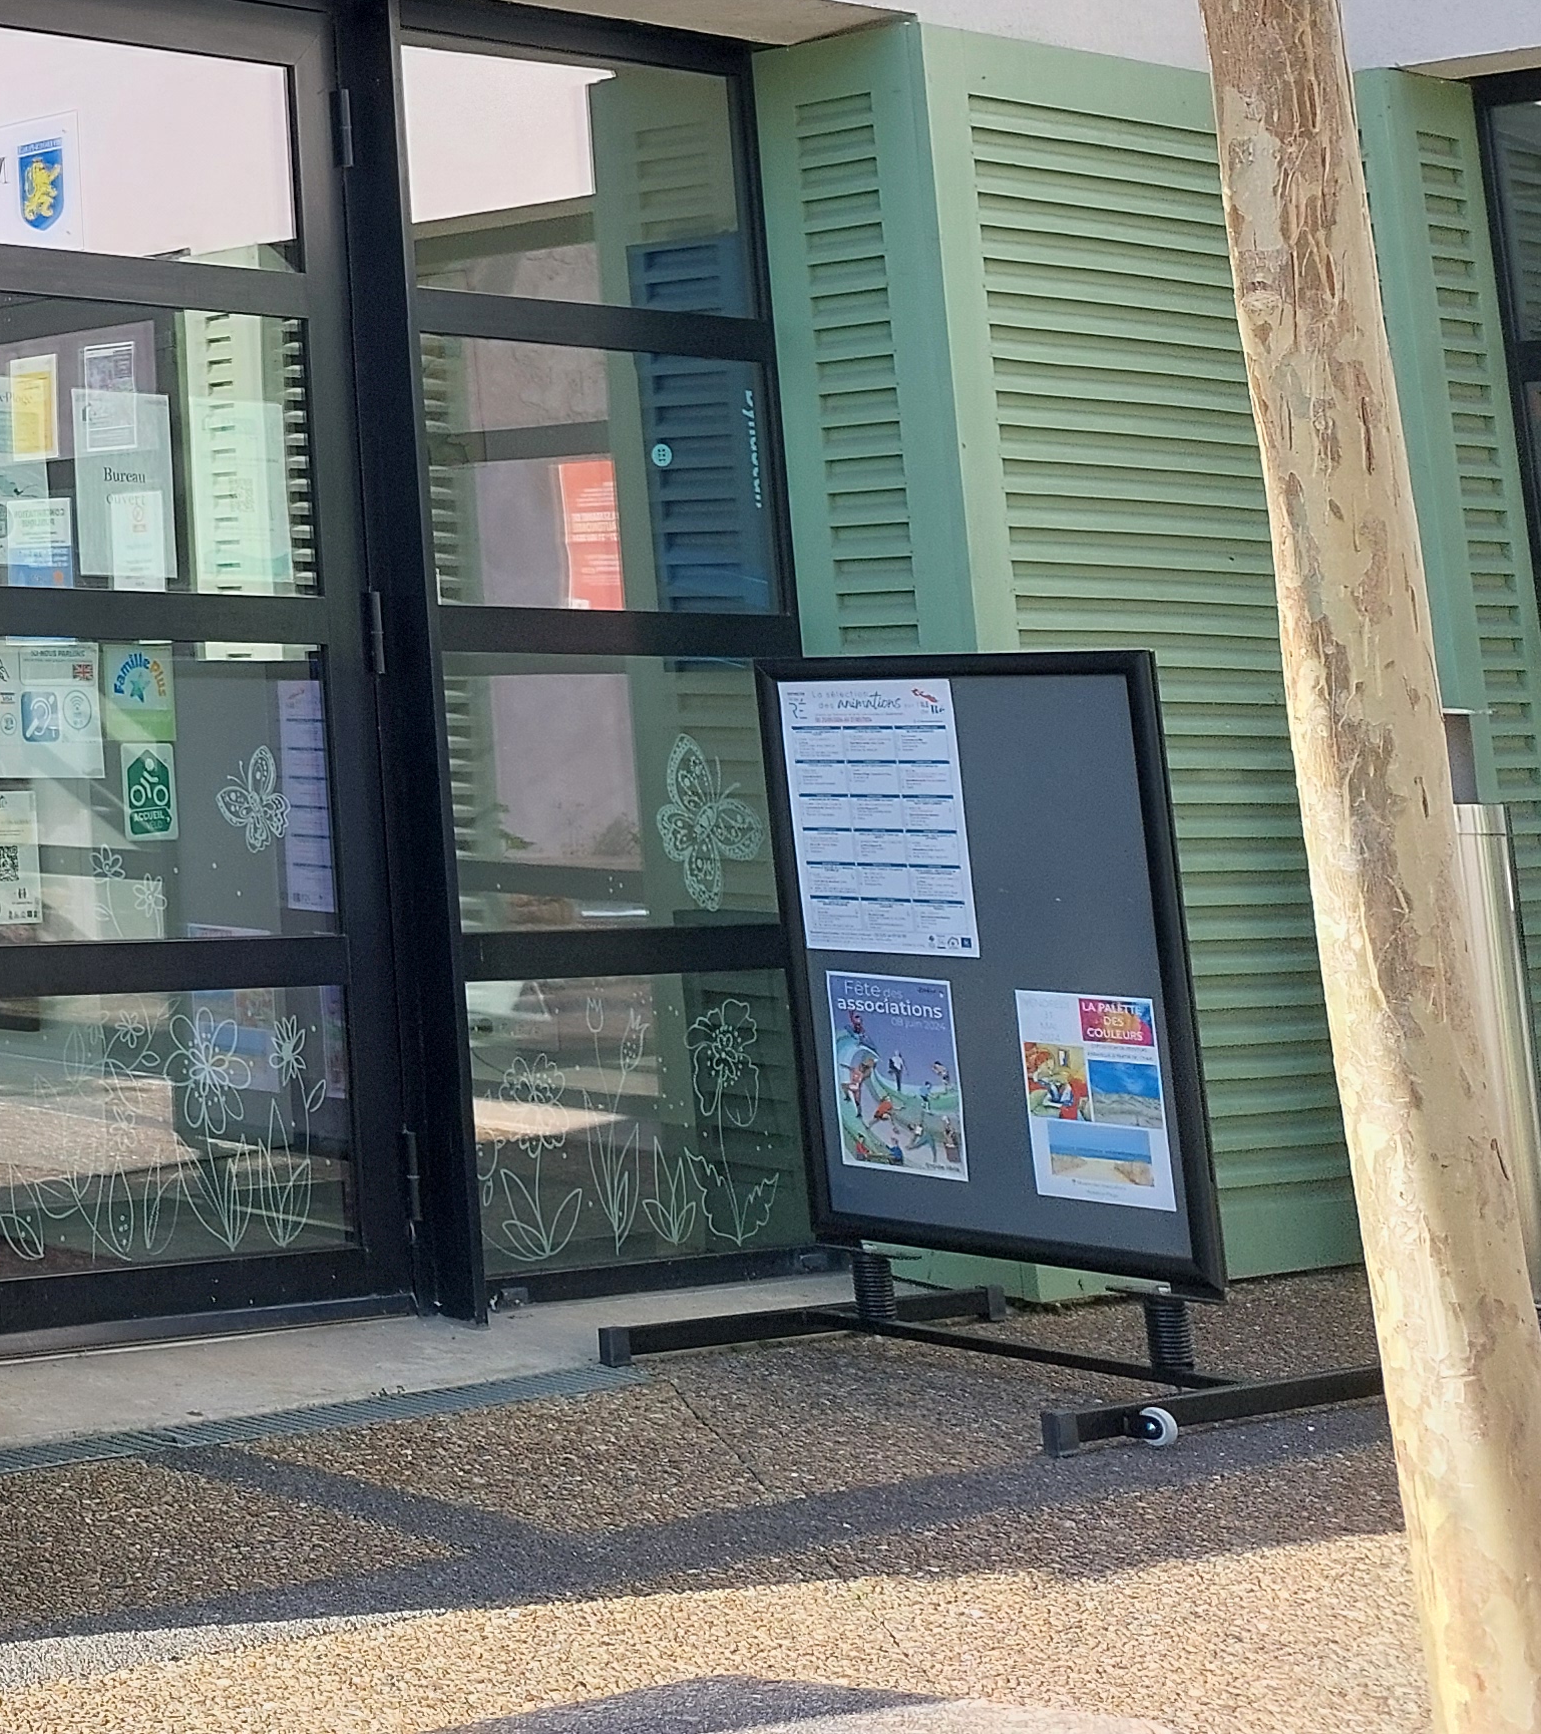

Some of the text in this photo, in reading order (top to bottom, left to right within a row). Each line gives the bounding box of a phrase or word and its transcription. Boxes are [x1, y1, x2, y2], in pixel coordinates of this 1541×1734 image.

[103, 466, 146, 483] Bureau
[114, 652, 151, 695] Famille
[844, 979, 880, 998] Fête
[837, 996, 943, 1019] associations
[1081, 1001, 1142, 1016] LA PALETTE
[1103, 1016, 1125, 1027] DES
[1086, 1027, 1143, 1041] COULEURS
